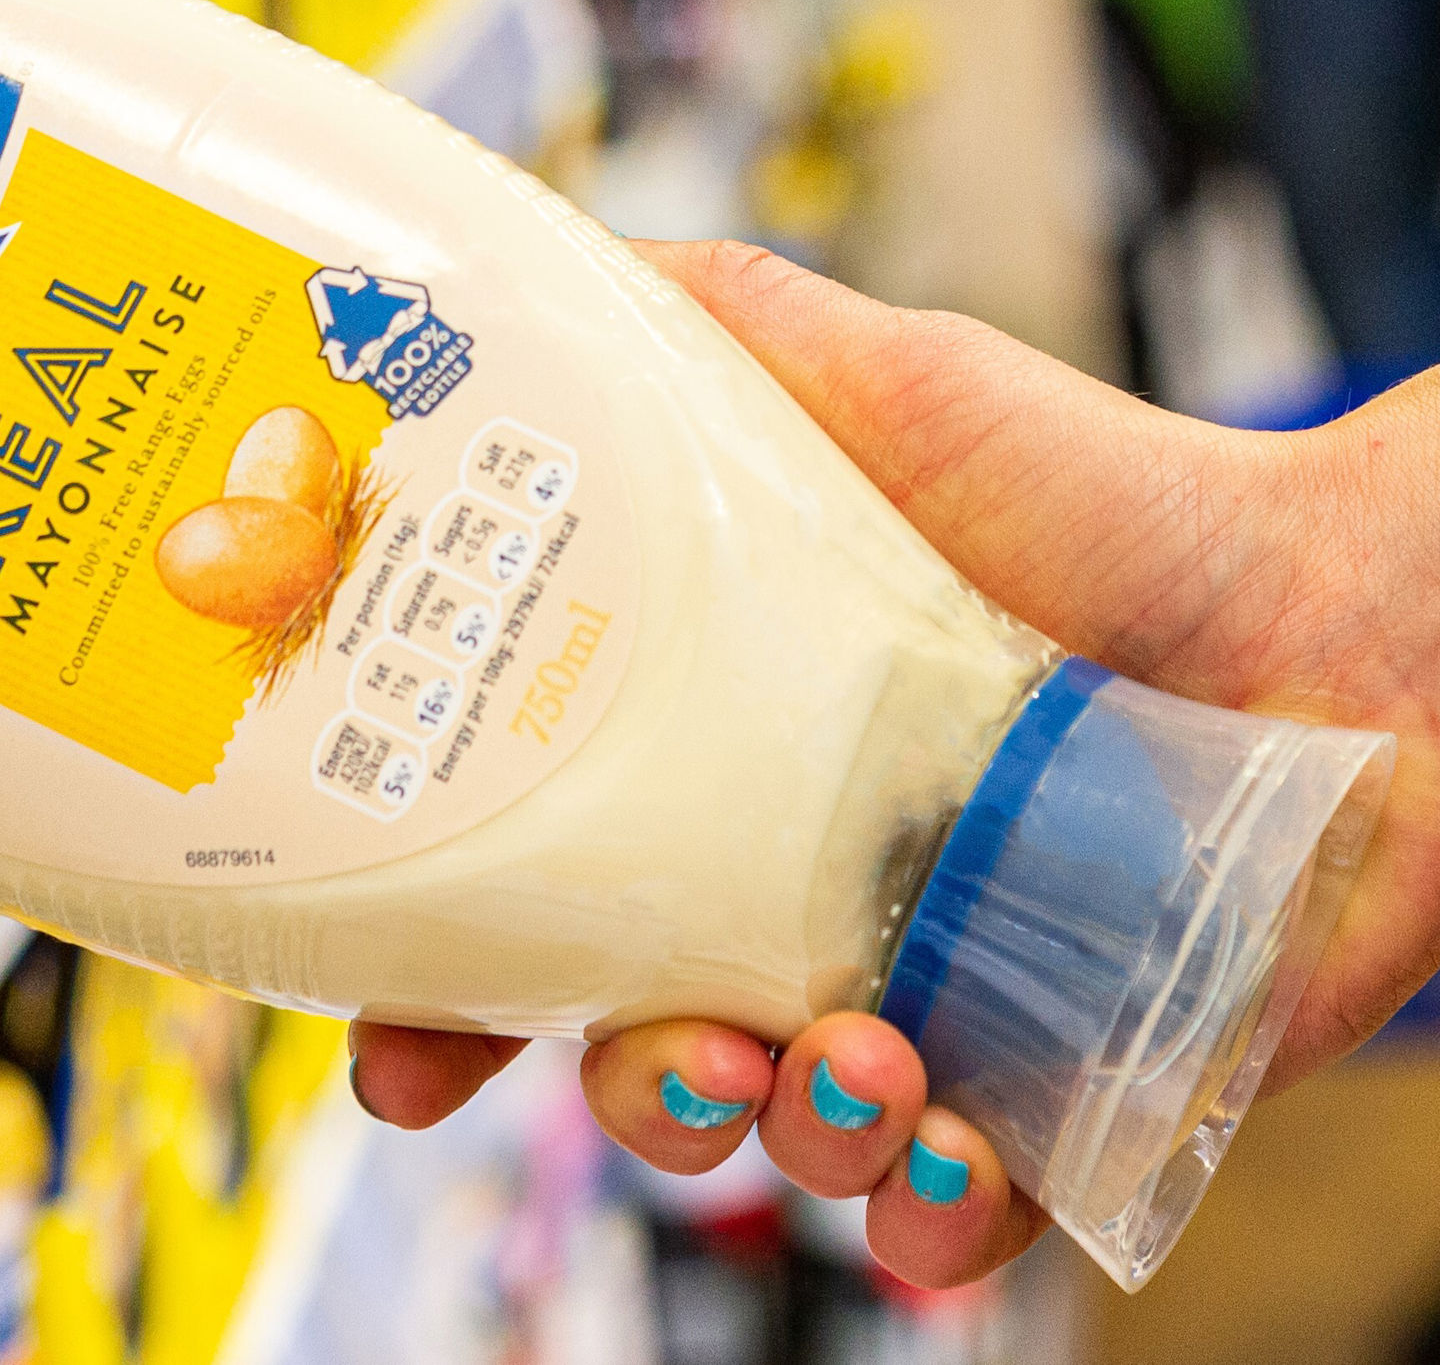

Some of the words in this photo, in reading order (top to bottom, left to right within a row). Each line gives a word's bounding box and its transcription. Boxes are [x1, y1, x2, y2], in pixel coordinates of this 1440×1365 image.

[375, 322, 451, 396] 100%
[387, 334, 472, 418] RECYCLABLE
[416, 359, 468, 413] BOTTLE
[0, 273, 206, 636] MAYONNAISE
[72, 537, 111, 589] 100%
[100, 482, 137, 532] Free
[126, 407, 176, 478] Range
[165, 353, 207, 405] Eggs
[478, 442, 508, 476] Salt
[497, 448, 537, 491] 0.21g
[59, 561, 130, 687] Committed
[122, 537, 143, 561] to
[137, 410, 210, 534] sustainably
[201, 325, 255, 410] sourced
[249, 287, 278, 326] oils
[433, 505, 473, 558] Sugars
[336, 625, 361, 657] Per
[355, 562, 394, 628] portion
[392, 569, 438, 638] Saturates
[423, 597, 457, 632] 0.9g
[366, 662, 392, 692] Fat
[389, 673, 419, 701] 11g
[508, 597, 613, 747] 750ml
[318, 722, 361, 779] Energy
[354, 735, 392, 795] 102kcal
[433, 722, 477, 784] Energy
[466, 689, 488, 724] per
[185, 848, 275, 868] 68879614
